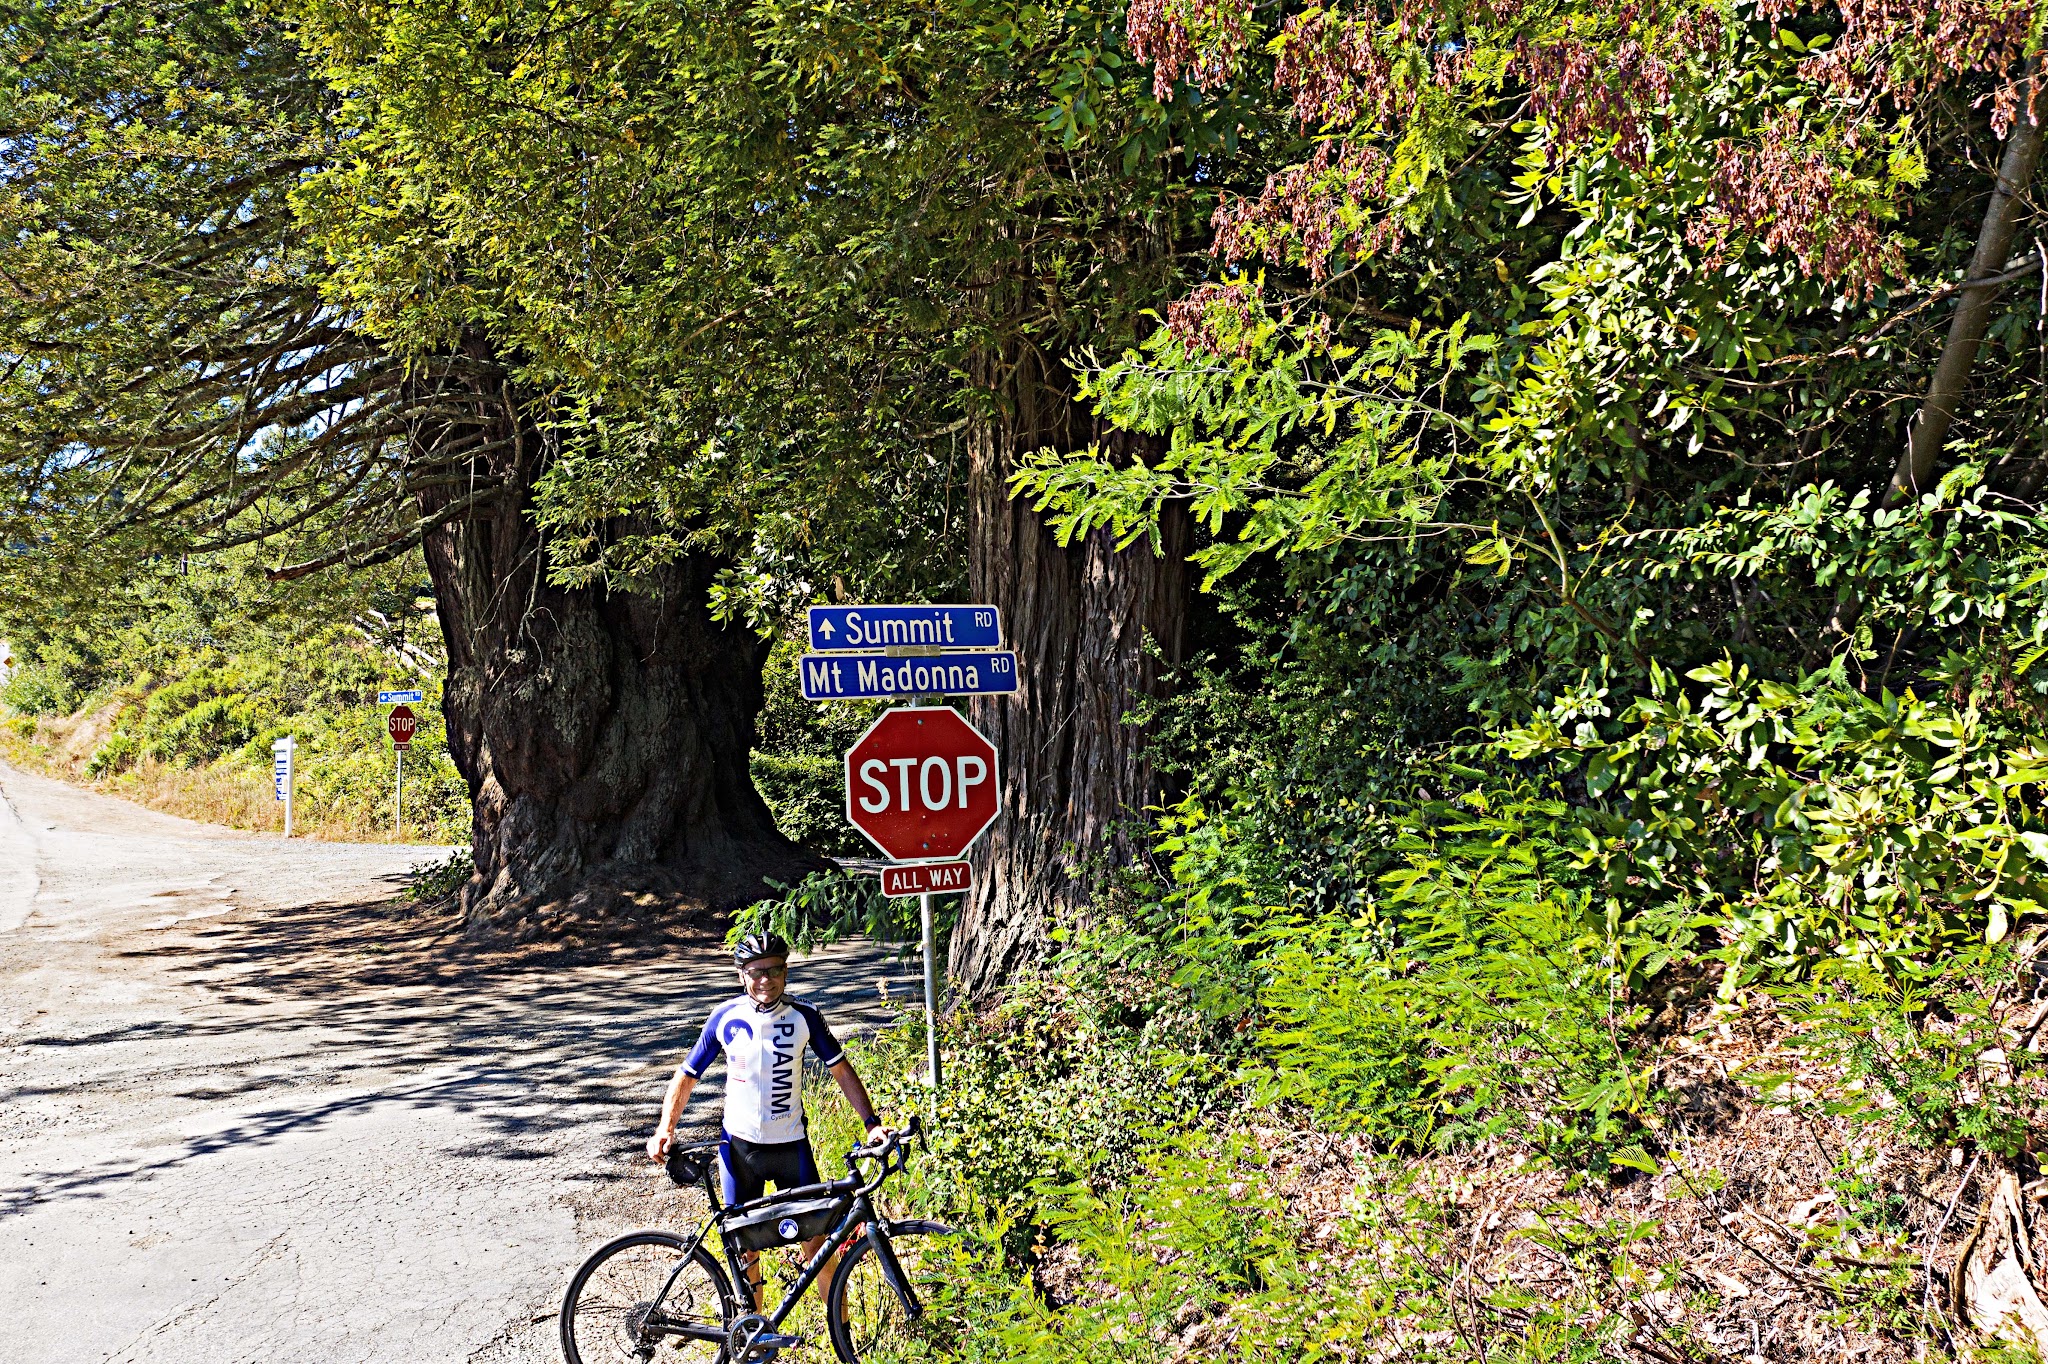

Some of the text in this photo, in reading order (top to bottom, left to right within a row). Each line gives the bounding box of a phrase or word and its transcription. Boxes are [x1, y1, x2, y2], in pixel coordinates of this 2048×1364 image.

[845, 611, 993, 645] Summit RD
[808, 657, 1010, 694] Mt Madonna RD
[387, 692, 415, 702] Summit
[389, 717, 415, 732] STOP
[858, 755, 988, 814] STOP
[891, 868, 965, 891] ALL WAY
[771, 1023, 794, 1114] PJAMM
